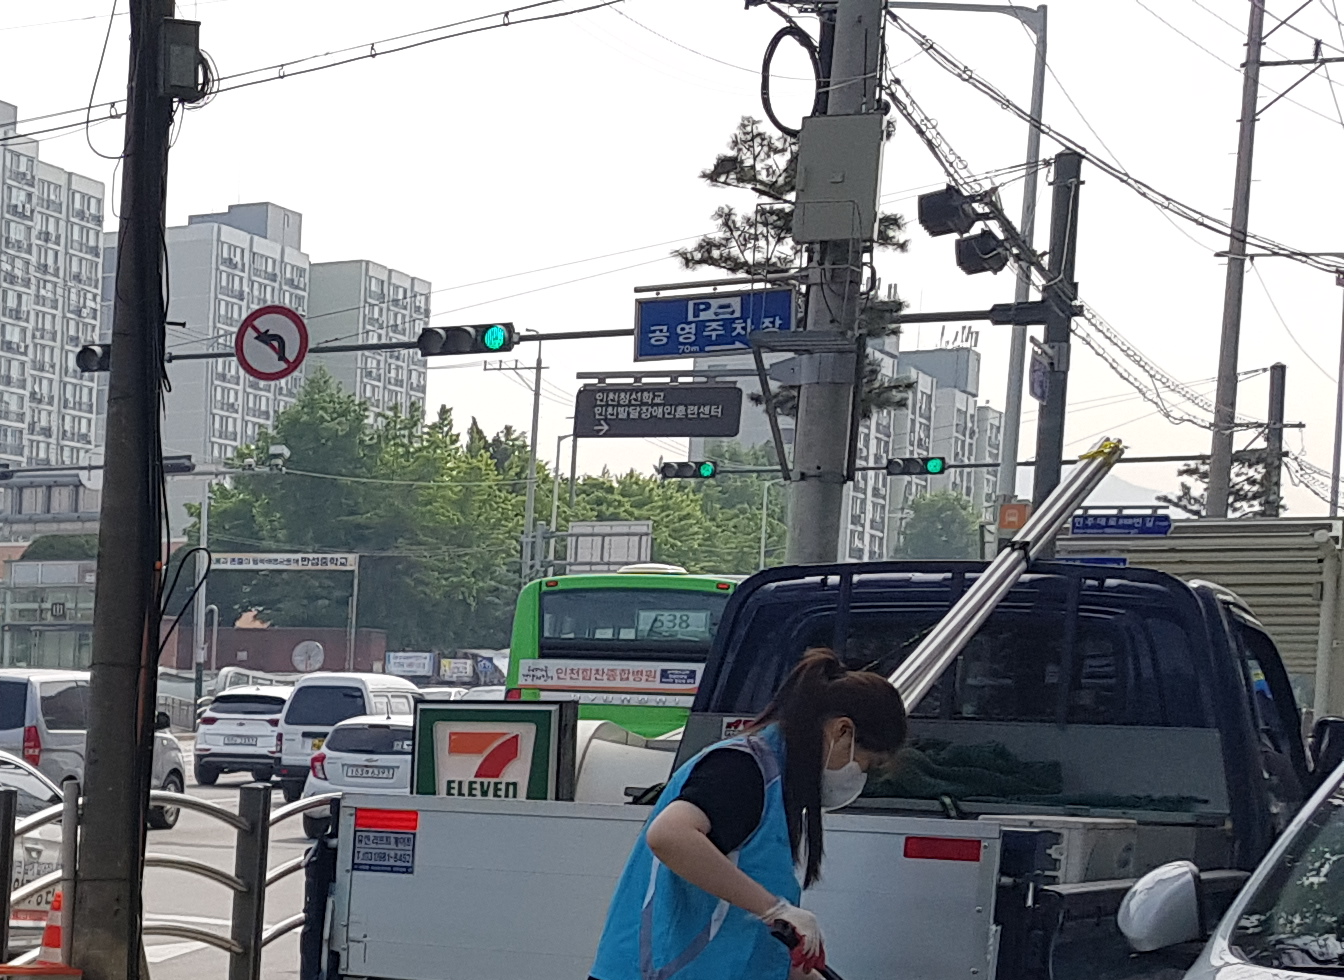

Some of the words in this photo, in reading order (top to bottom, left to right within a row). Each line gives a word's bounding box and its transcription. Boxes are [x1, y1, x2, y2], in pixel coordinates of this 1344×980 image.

[648, 316, 783, 346] 공영주차장
[678, 345, 700, 354] 70m
[448, 732, 520, 779] 7
